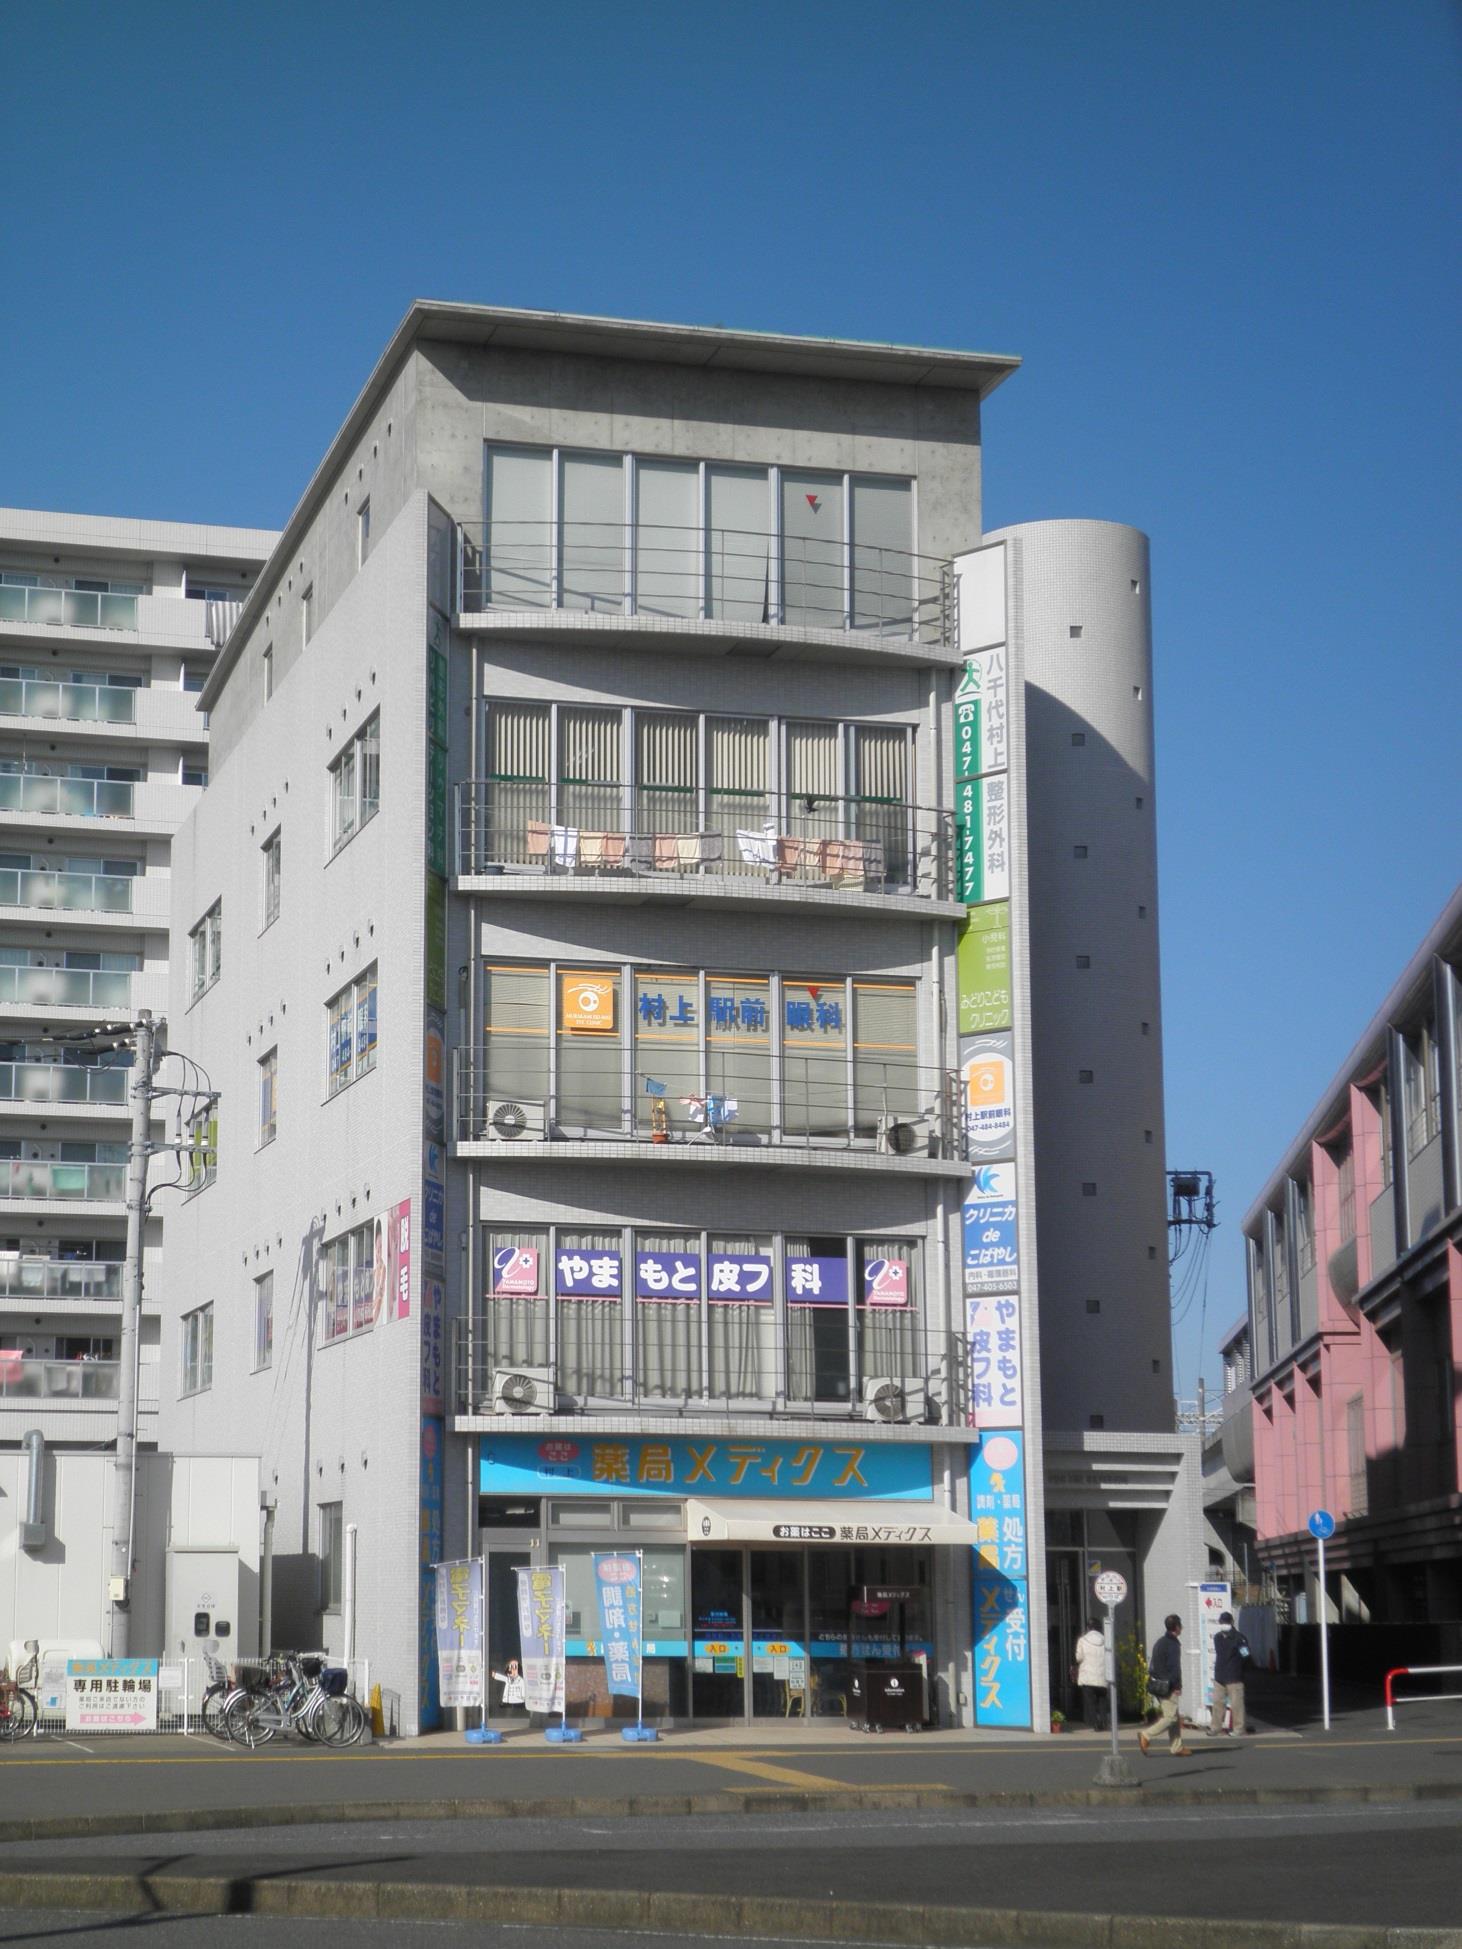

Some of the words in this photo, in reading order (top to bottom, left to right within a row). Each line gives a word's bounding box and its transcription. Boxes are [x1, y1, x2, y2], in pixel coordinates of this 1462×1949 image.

[960, 989, 1009, 1009] みどりこども
[970, 1008, 1009, 1029] クリニック
[965, 1205, 1016, 1225] クリニカ
[982, 1227, 1000, 1243] de
[966, 1247, 1017, 1265] こばやし
[995, 1299, 1017, 1406] やまもと
[973, 1330, 993, 1408] 皮フ科
[591, 1444, 868, 1486] 薬局メディクス
[779, 1526, 830, 1539] お薬はここ
[840, 1526, 932, 1542] 薬局メディクス
[710, 1644, 727, 1653] 入口
[770, 1644, 787, 1653] 入口
[73, 1679, 152, 1693] 専用駐輪場
